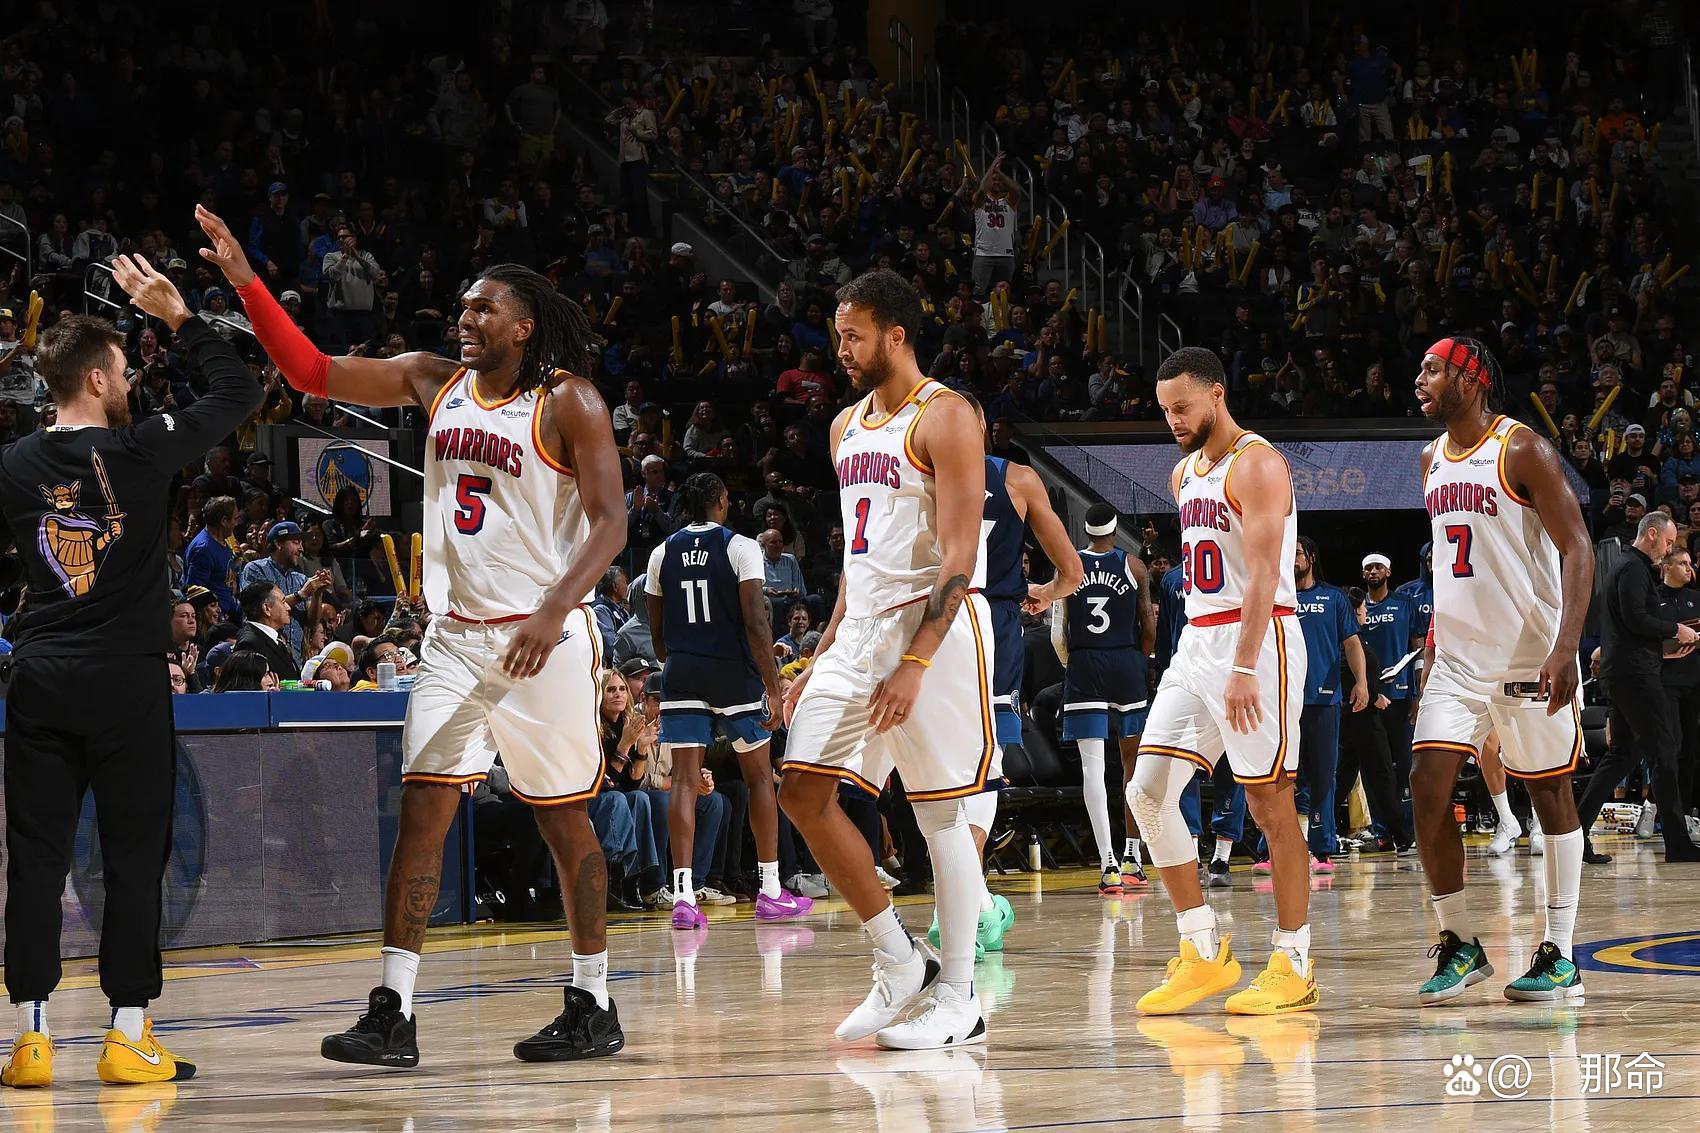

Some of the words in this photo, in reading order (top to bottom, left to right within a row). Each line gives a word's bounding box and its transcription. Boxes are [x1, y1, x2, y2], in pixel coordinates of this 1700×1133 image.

[501, 409, 530, 418] Rakuten
[436, 428, 523, 478] WARRIORS
[1469, 459, 1494, 467] Rakuten
[454, 474, 492, 536] 5
[1426, 482, 1498, 519] WARRIORS
[851, 497, 871, 555] 1
[681, 550, 709, 567] REID
[1182, 540, 1224, 595] 30
[1445, 524, 1474, 578] 7
[681, 580, 711, 623] 11
[1073, 571, 1129, 596] DANIELS
[1086, 597, 1110, 634] 3
